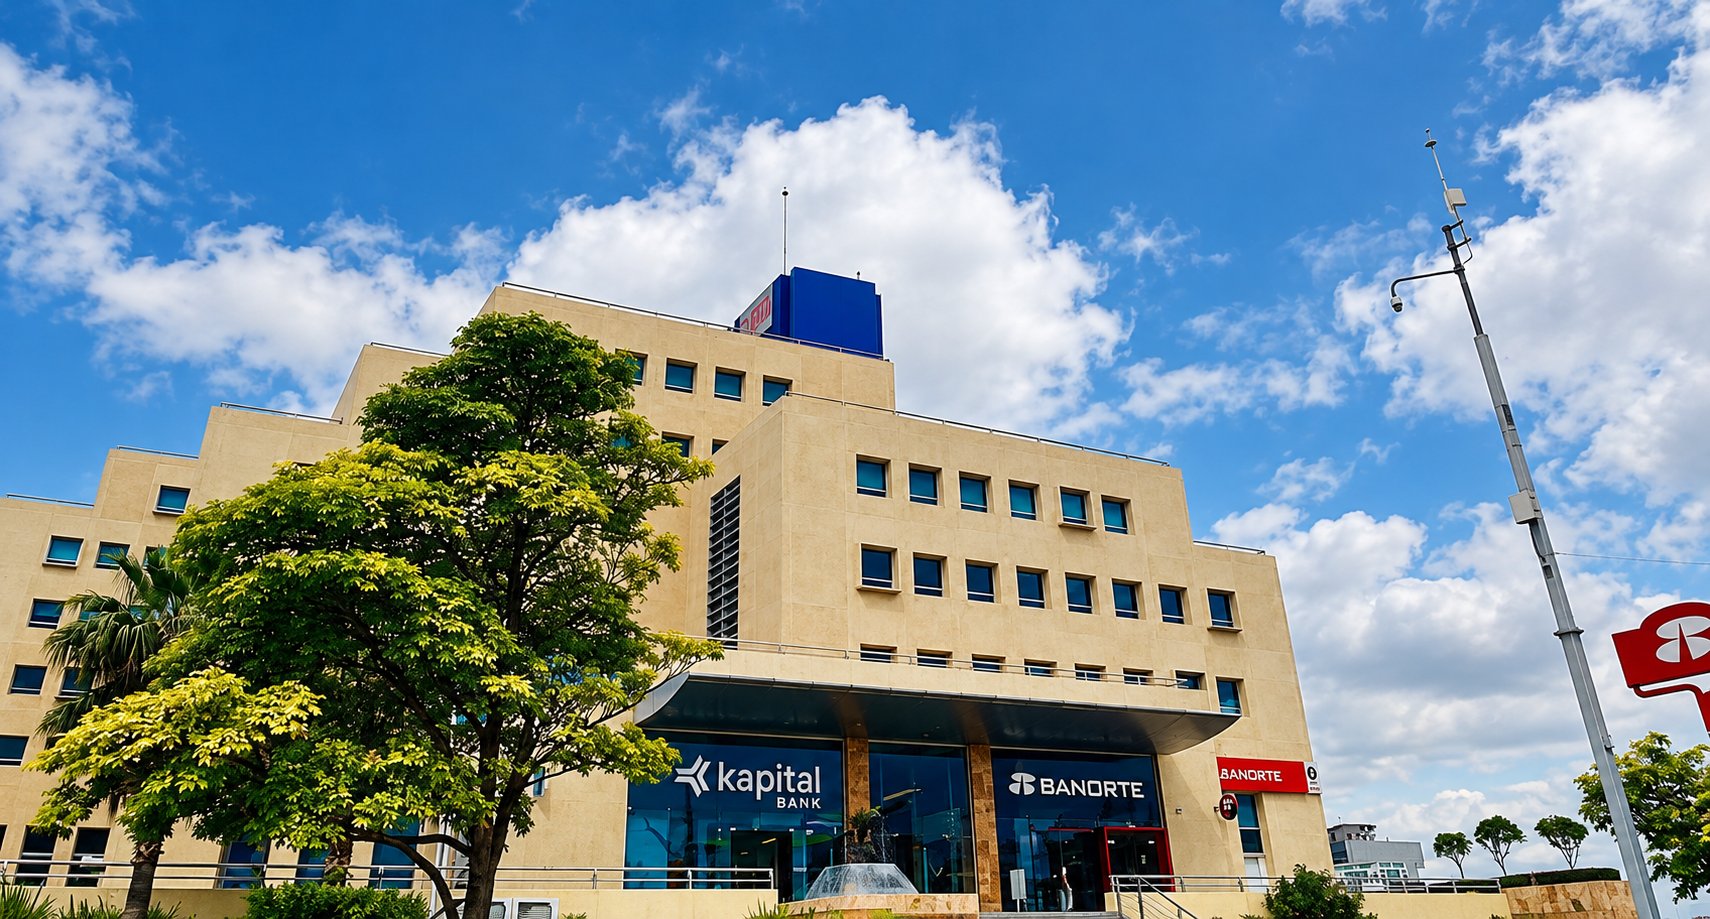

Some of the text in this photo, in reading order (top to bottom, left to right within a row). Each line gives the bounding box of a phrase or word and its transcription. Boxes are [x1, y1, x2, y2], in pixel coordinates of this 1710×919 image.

[718, 761, 821, 800] kapital
[1219, 768, 1283, 782] BANORTE
[1040, 778, 1145, 798] BANORTE
[776, 797, 821, 809] BANK
